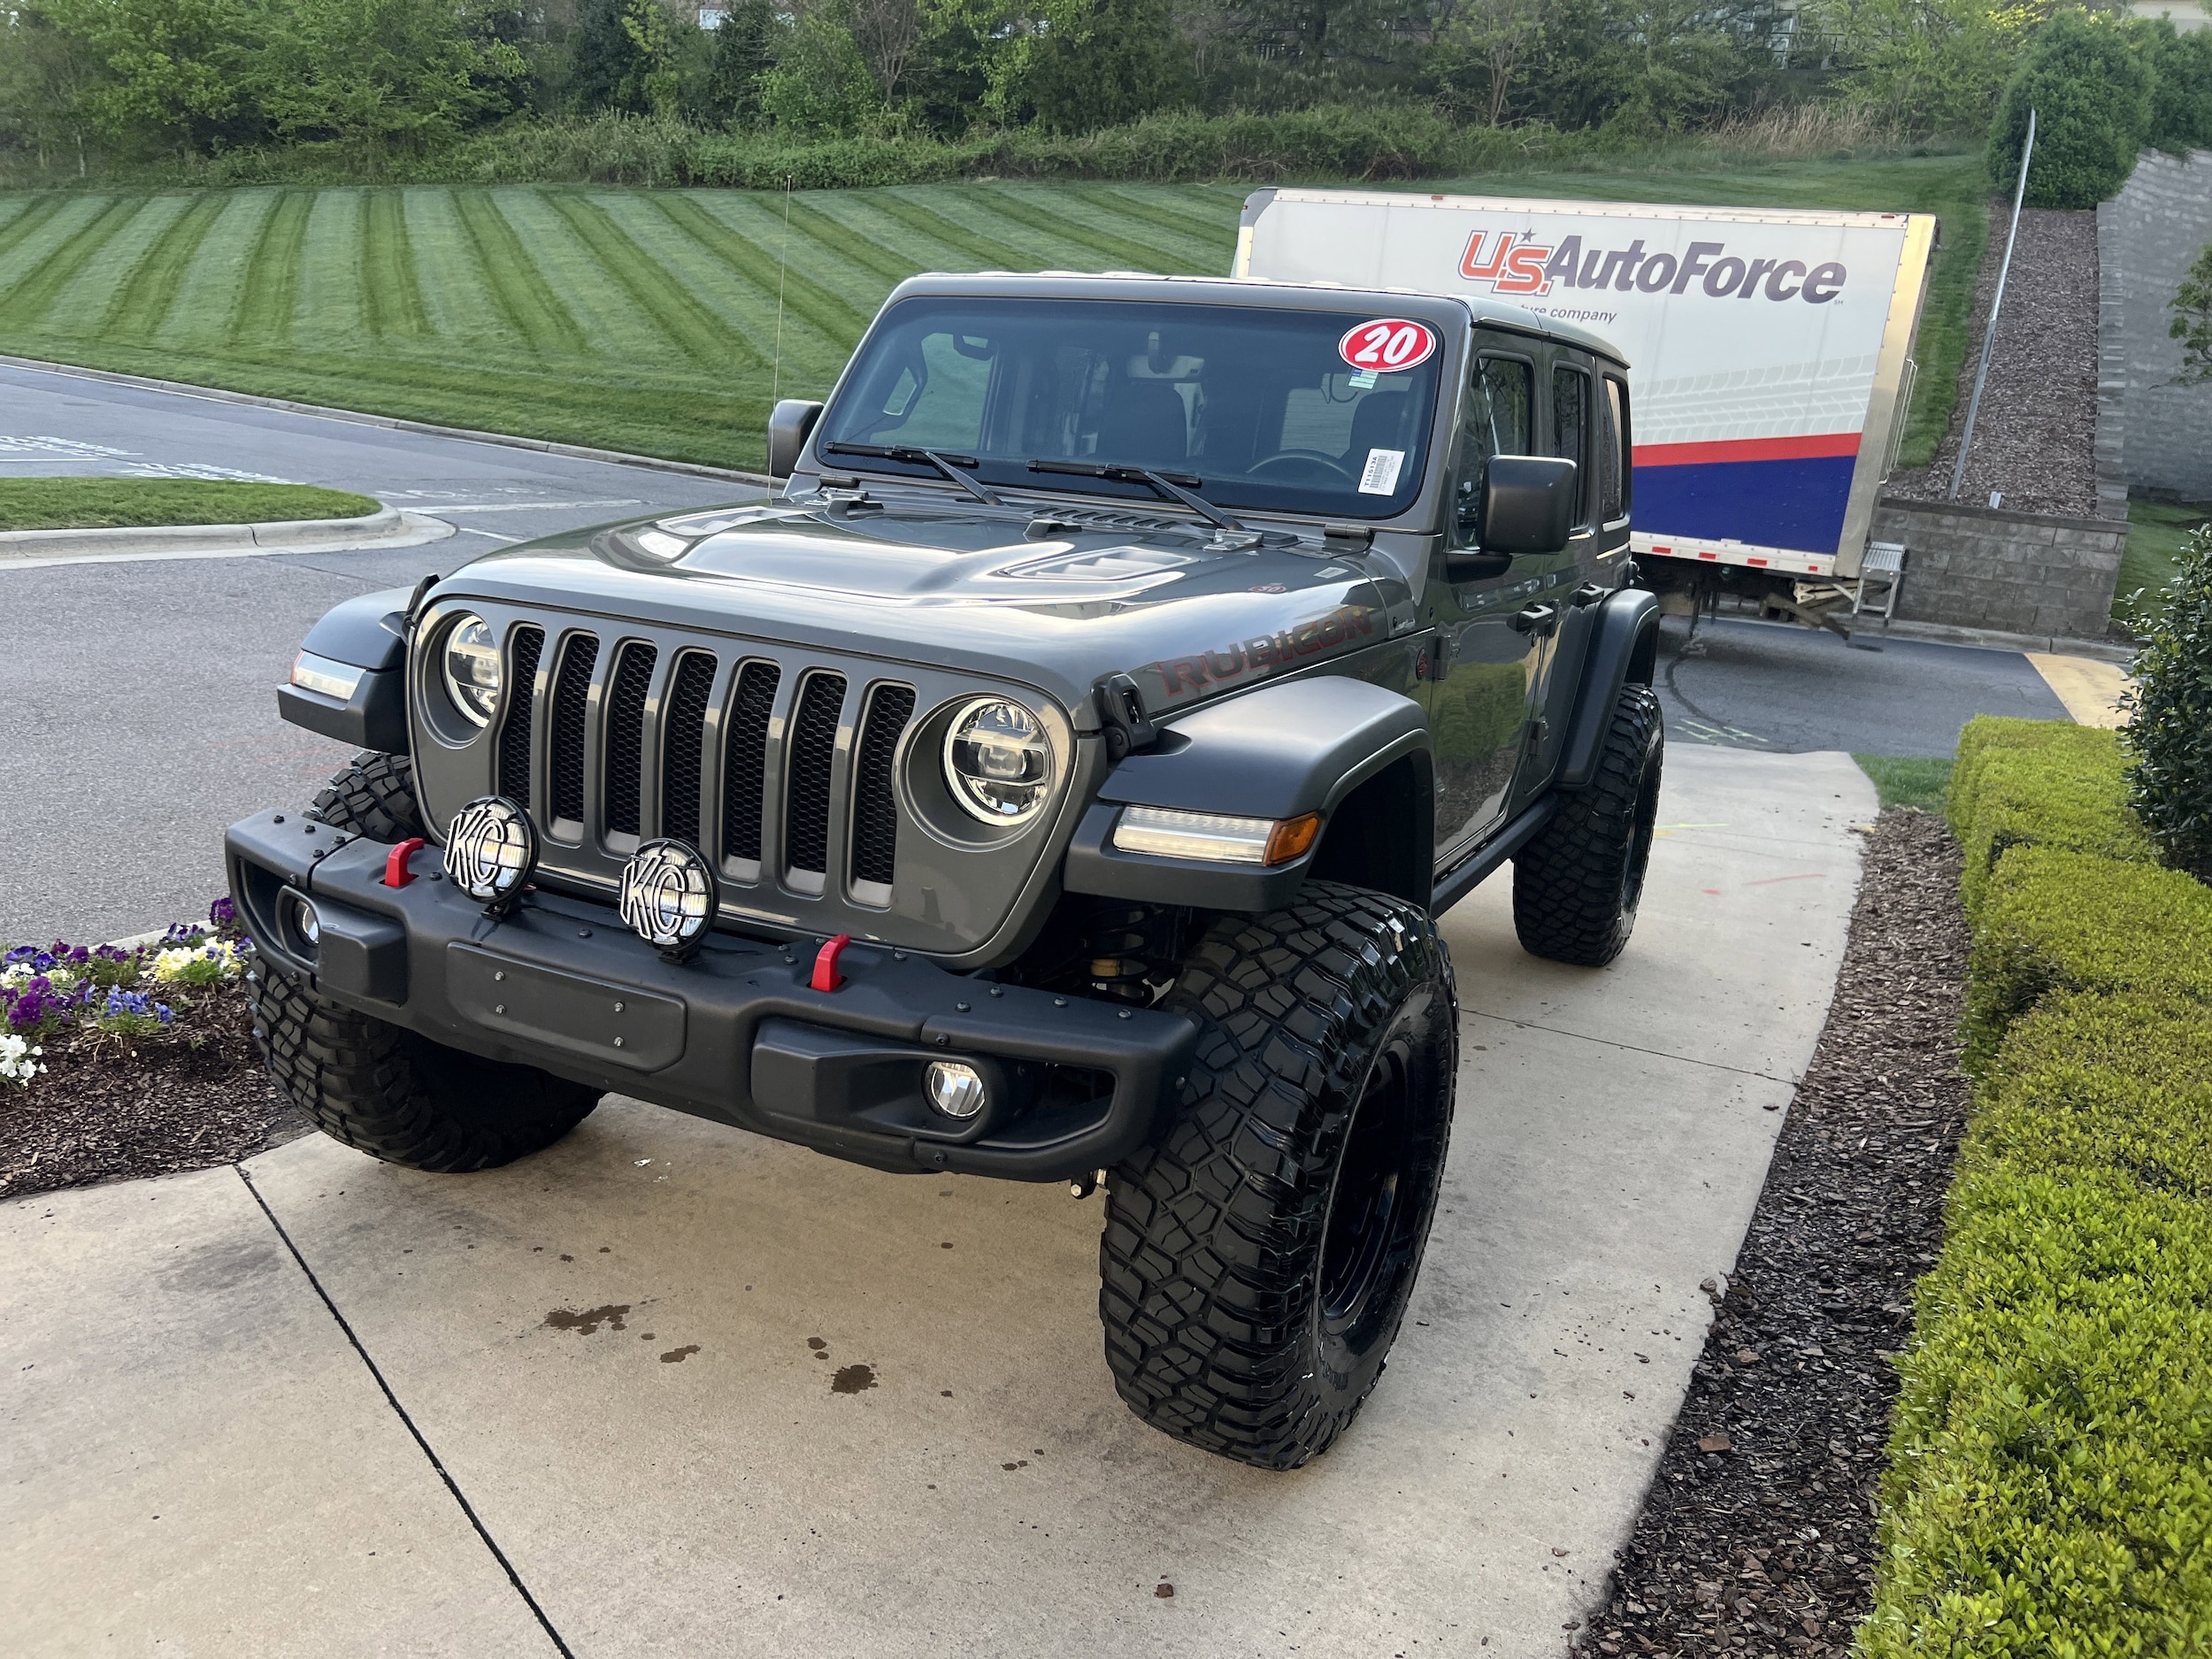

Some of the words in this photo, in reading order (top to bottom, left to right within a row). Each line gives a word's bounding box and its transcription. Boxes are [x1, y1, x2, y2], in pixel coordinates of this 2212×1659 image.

[1354, 325, 1418, 365] 20
[1550, 308, 1617, 324] company
[1158, 605, 1372, 697] RUBICON
[443, 808, 505, 888] KC
[619, 855, 685, 940] KC
